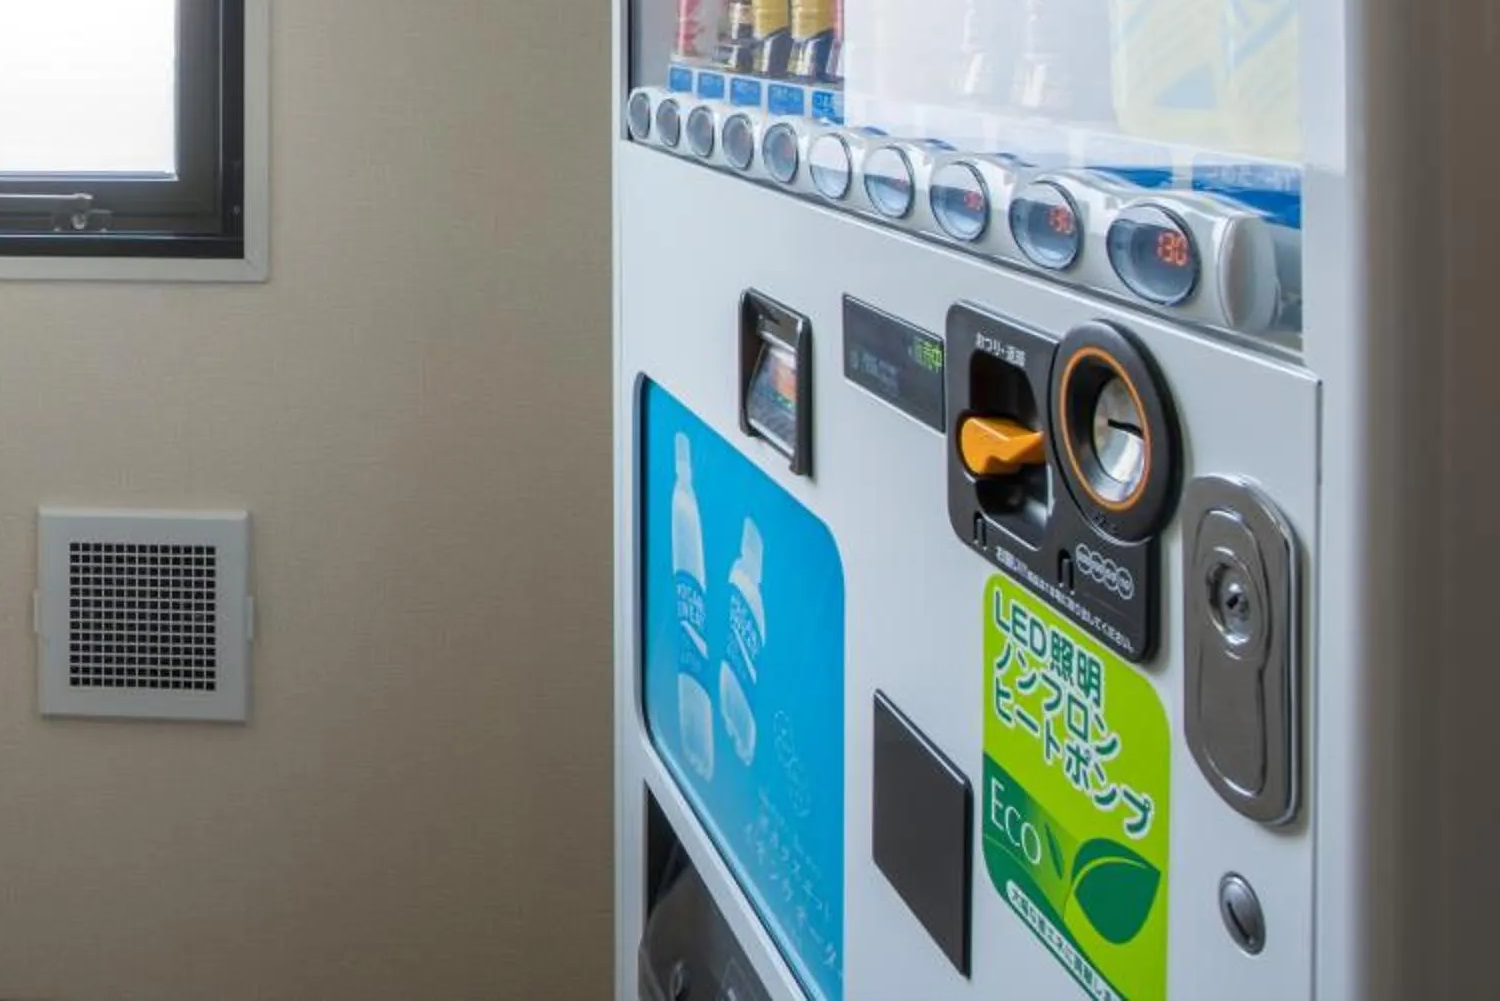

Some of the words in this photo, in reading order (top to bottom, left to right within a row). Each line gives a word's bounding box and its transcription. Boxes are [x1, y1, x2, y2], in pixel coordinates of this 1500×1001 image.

[994, 589, 1102, 708] LED照明
[995, 643, 1119, 757] ノンフロン
[994, 683, 1153, 836] ヒートポンプ
[990, 777, 1041, 866] ECO
